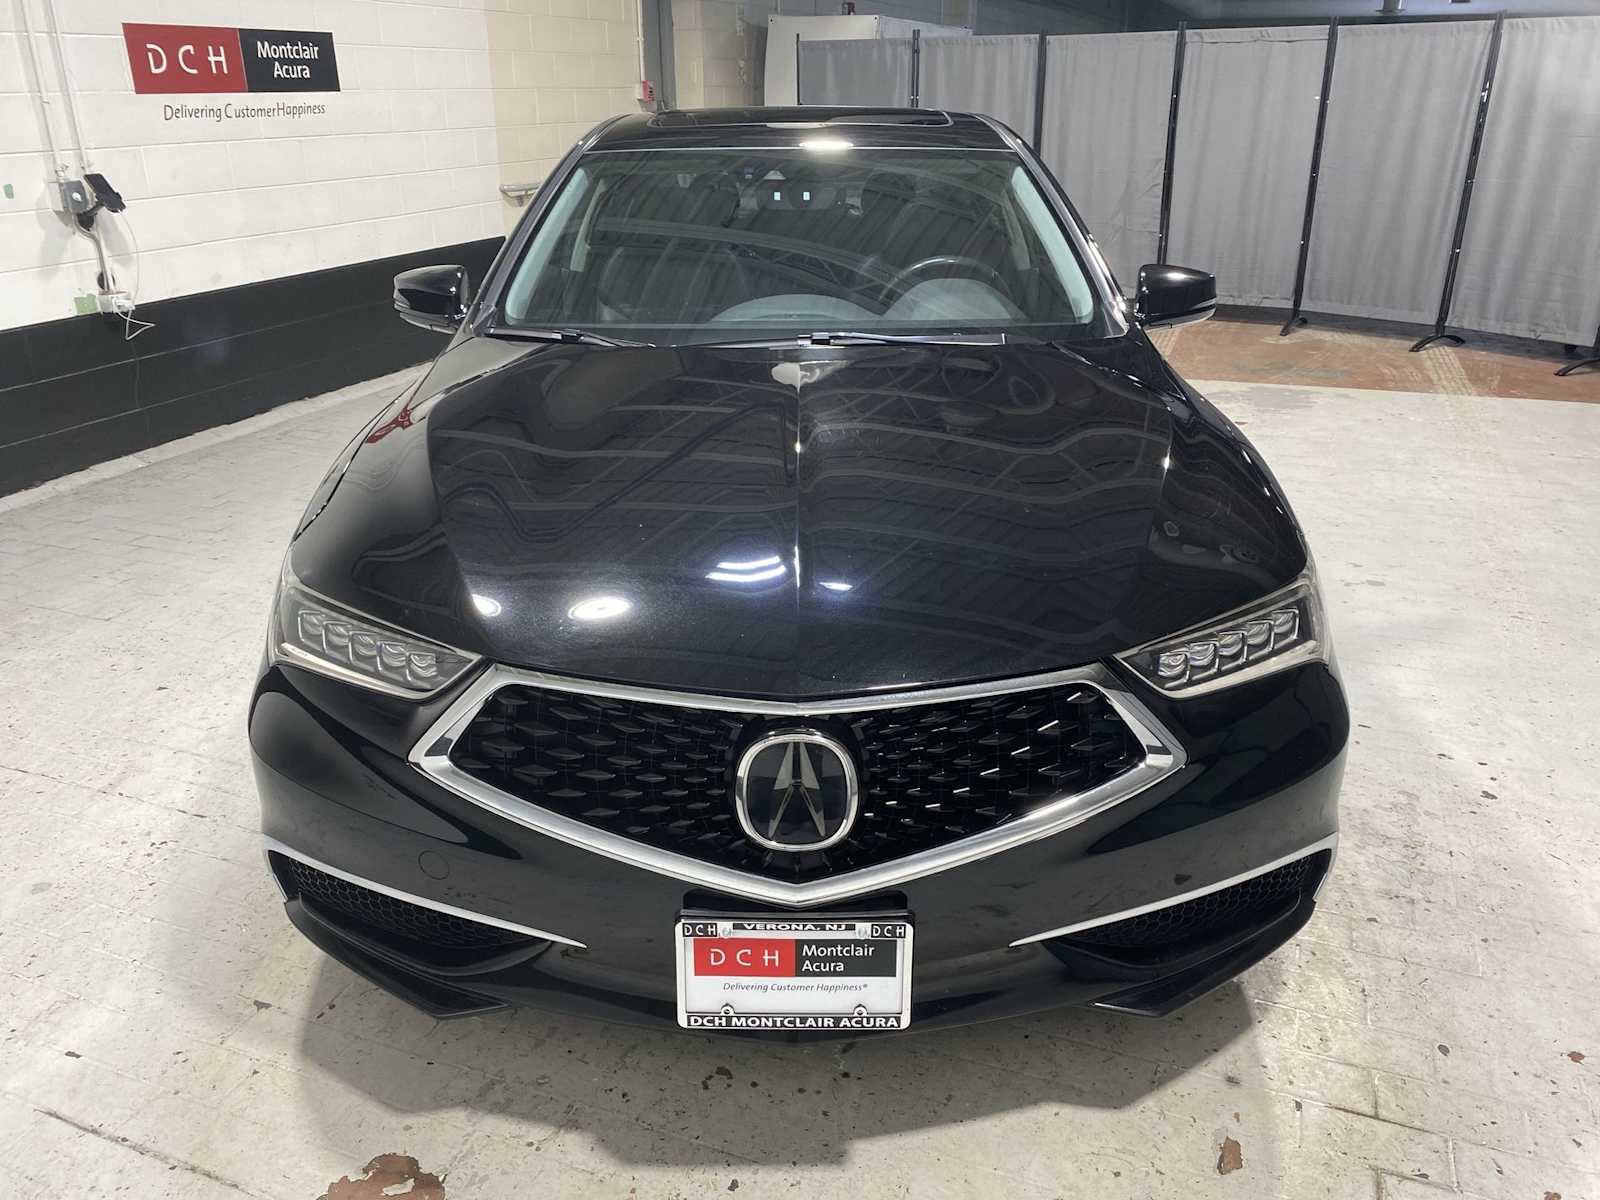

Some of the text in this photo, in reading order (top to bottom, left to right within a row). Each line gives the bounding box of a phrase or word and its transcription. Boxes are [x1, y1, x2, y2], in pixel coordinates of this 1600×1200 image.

[256, 40, 319, 60] Montclair
[146, 43, 228, 74] DCH
[273, 61, 310, 79] Acura
[163, 104, 222, 122] Delivering
[684, 924, 717, 936] DCH
[872, 925, 905, 937] DCH
[802, 944, 875, 957] Montclair
[710, 948, 779, 967] DCH
[801, 960, 845, 972] Acura
[723, 982, 769, 993] Delivering
[770, 983, 815, 992] Customer
[689, 1016, 899, 1028] DCH MONTCLAIR ACURA
